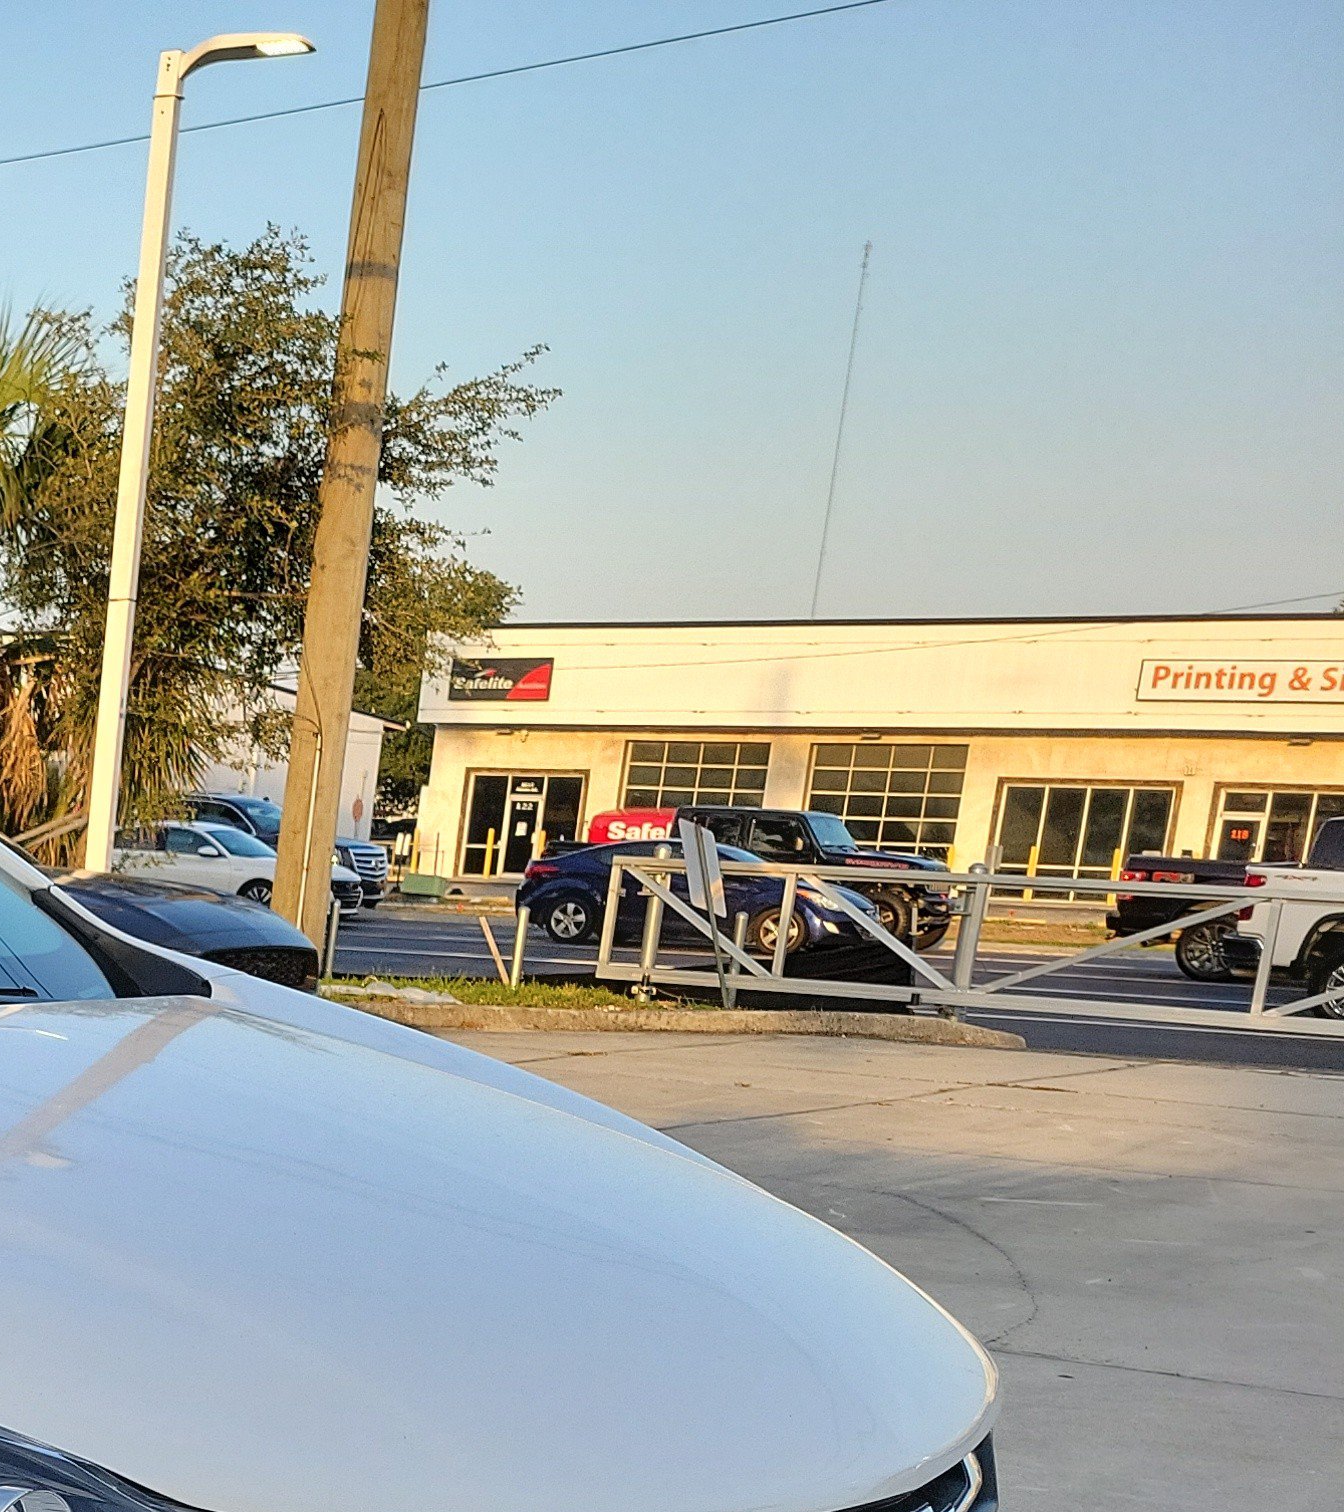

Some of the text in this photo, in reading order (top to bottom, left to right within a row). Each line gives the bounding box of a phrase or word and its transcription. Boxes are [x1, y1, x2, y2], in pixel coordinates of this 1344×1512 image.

[453, 675, 514, 690] Safelite
[1151, 665, 1277, 697] Printing
[1288, 666, 1312, 691] &
